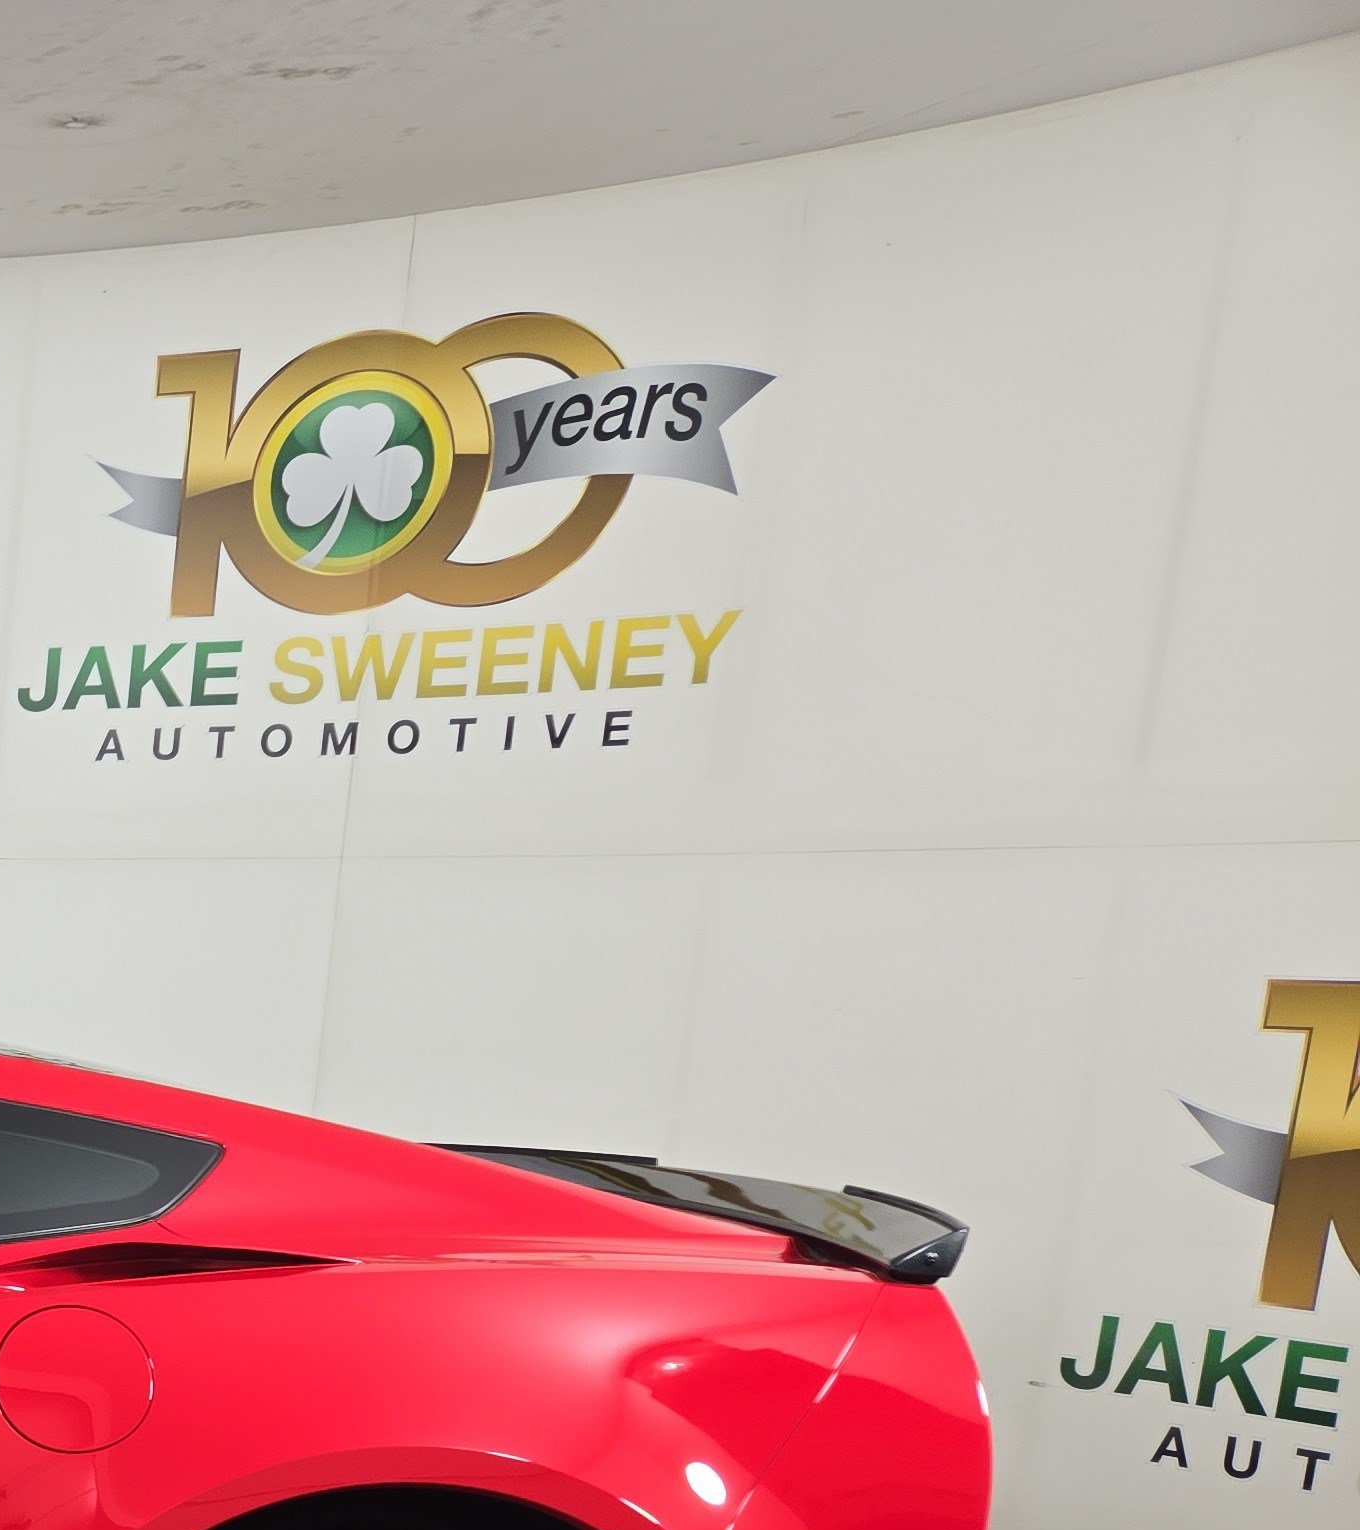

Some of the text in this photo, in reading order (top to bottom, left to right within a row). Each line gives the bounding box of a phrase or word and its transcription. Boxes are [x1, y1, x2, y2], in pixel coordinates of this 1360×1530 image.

[155, 311, 708, 619] 100 years
[17, 609, 742, 713] JAKE SWEENEY
[95, 709, 634, 763] AUTOMOTIVE
[1059, 1315, 1350, 1429] JAKE
[1150, 1426, 1331, 1491] AUT
